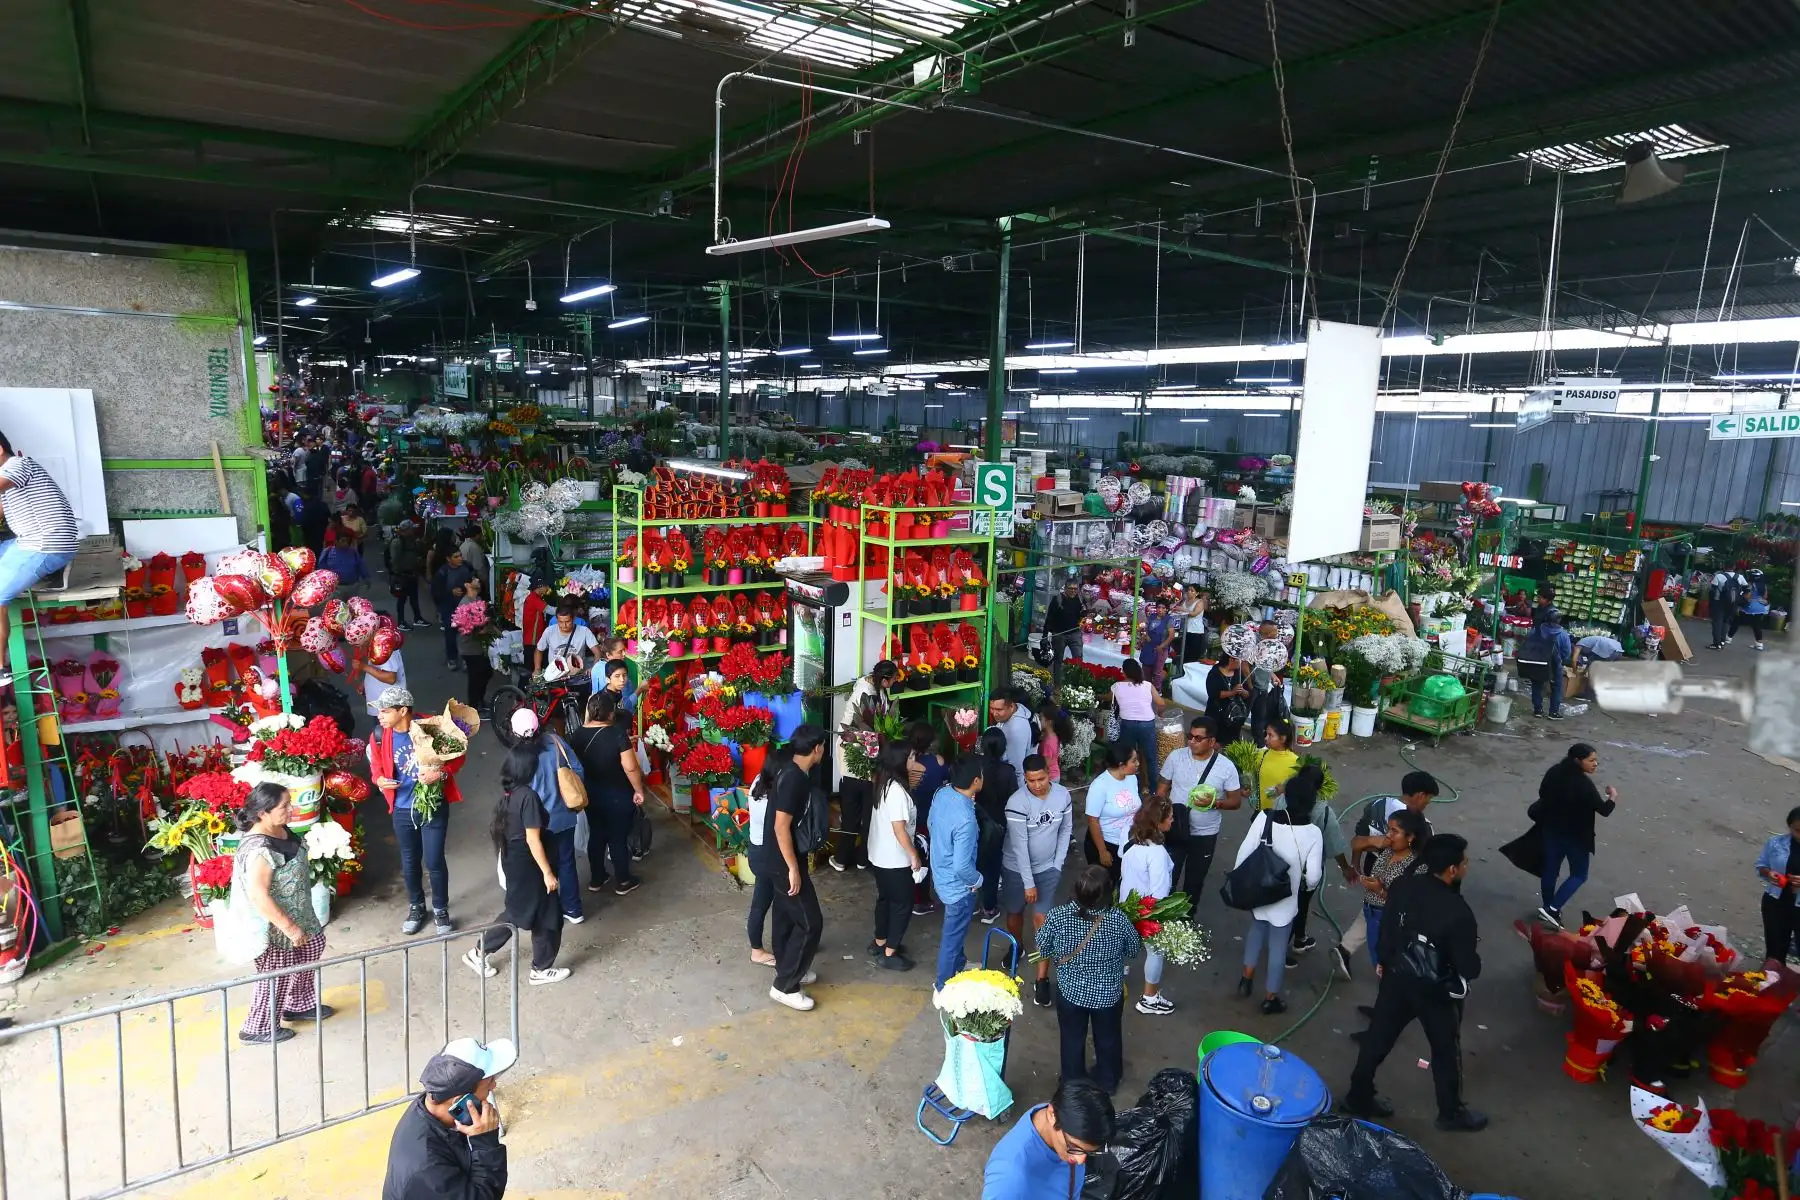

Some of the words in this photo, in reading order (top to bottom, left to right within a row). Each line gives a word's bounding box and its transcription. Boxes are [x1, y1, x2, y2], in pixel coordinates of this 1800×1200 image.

[661, 374, 668, 386] B
[1565, 389, 1617, 400] PASADISO
[1745, 415, 1800, 432] SALID
[983, 469, 1007, 507] S
[1032, 511, 1040, 519] 74
[1479, 552, 1524, 569] TULIPANES
[1291, 574, 1303, 584] 75
